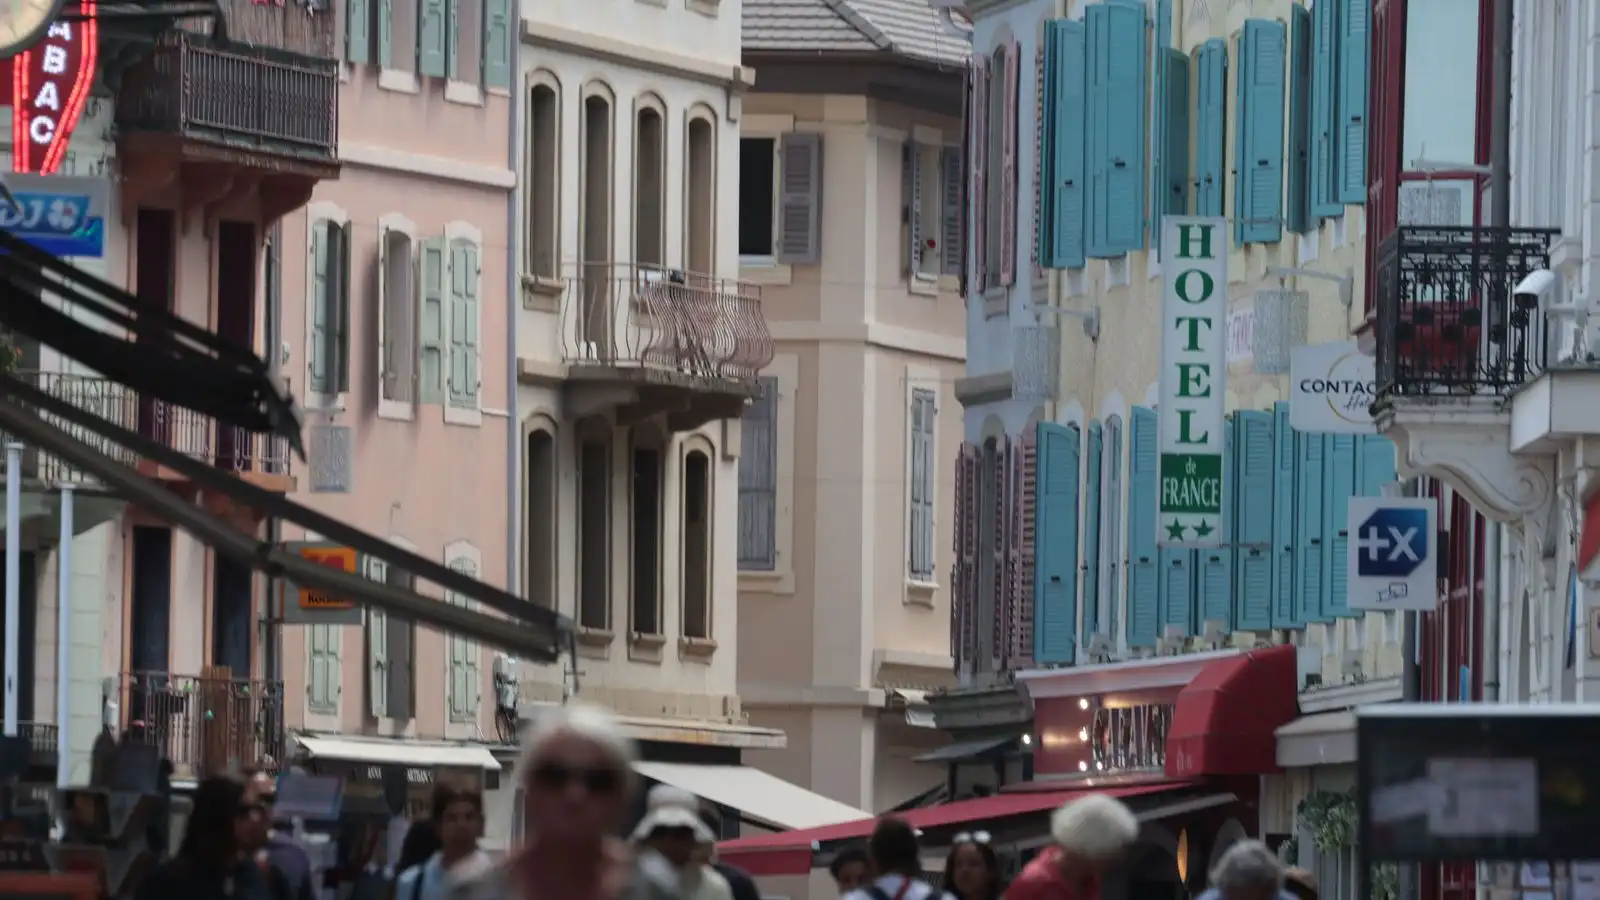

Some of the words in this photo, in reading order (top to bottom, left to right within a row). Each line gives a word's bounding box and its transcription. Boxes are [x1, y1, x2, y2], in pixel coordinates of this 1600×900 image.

[30, 21, 71, 144] ABAC
[0, 199, 45, 229] DJ
[1174, 223, 1216, 445] HOTEL
[1300, 378, 1377, 395] CONTAC
[1185, 456, 1197, 475] de
[1162, 475, 1219, 507] FRANCE
